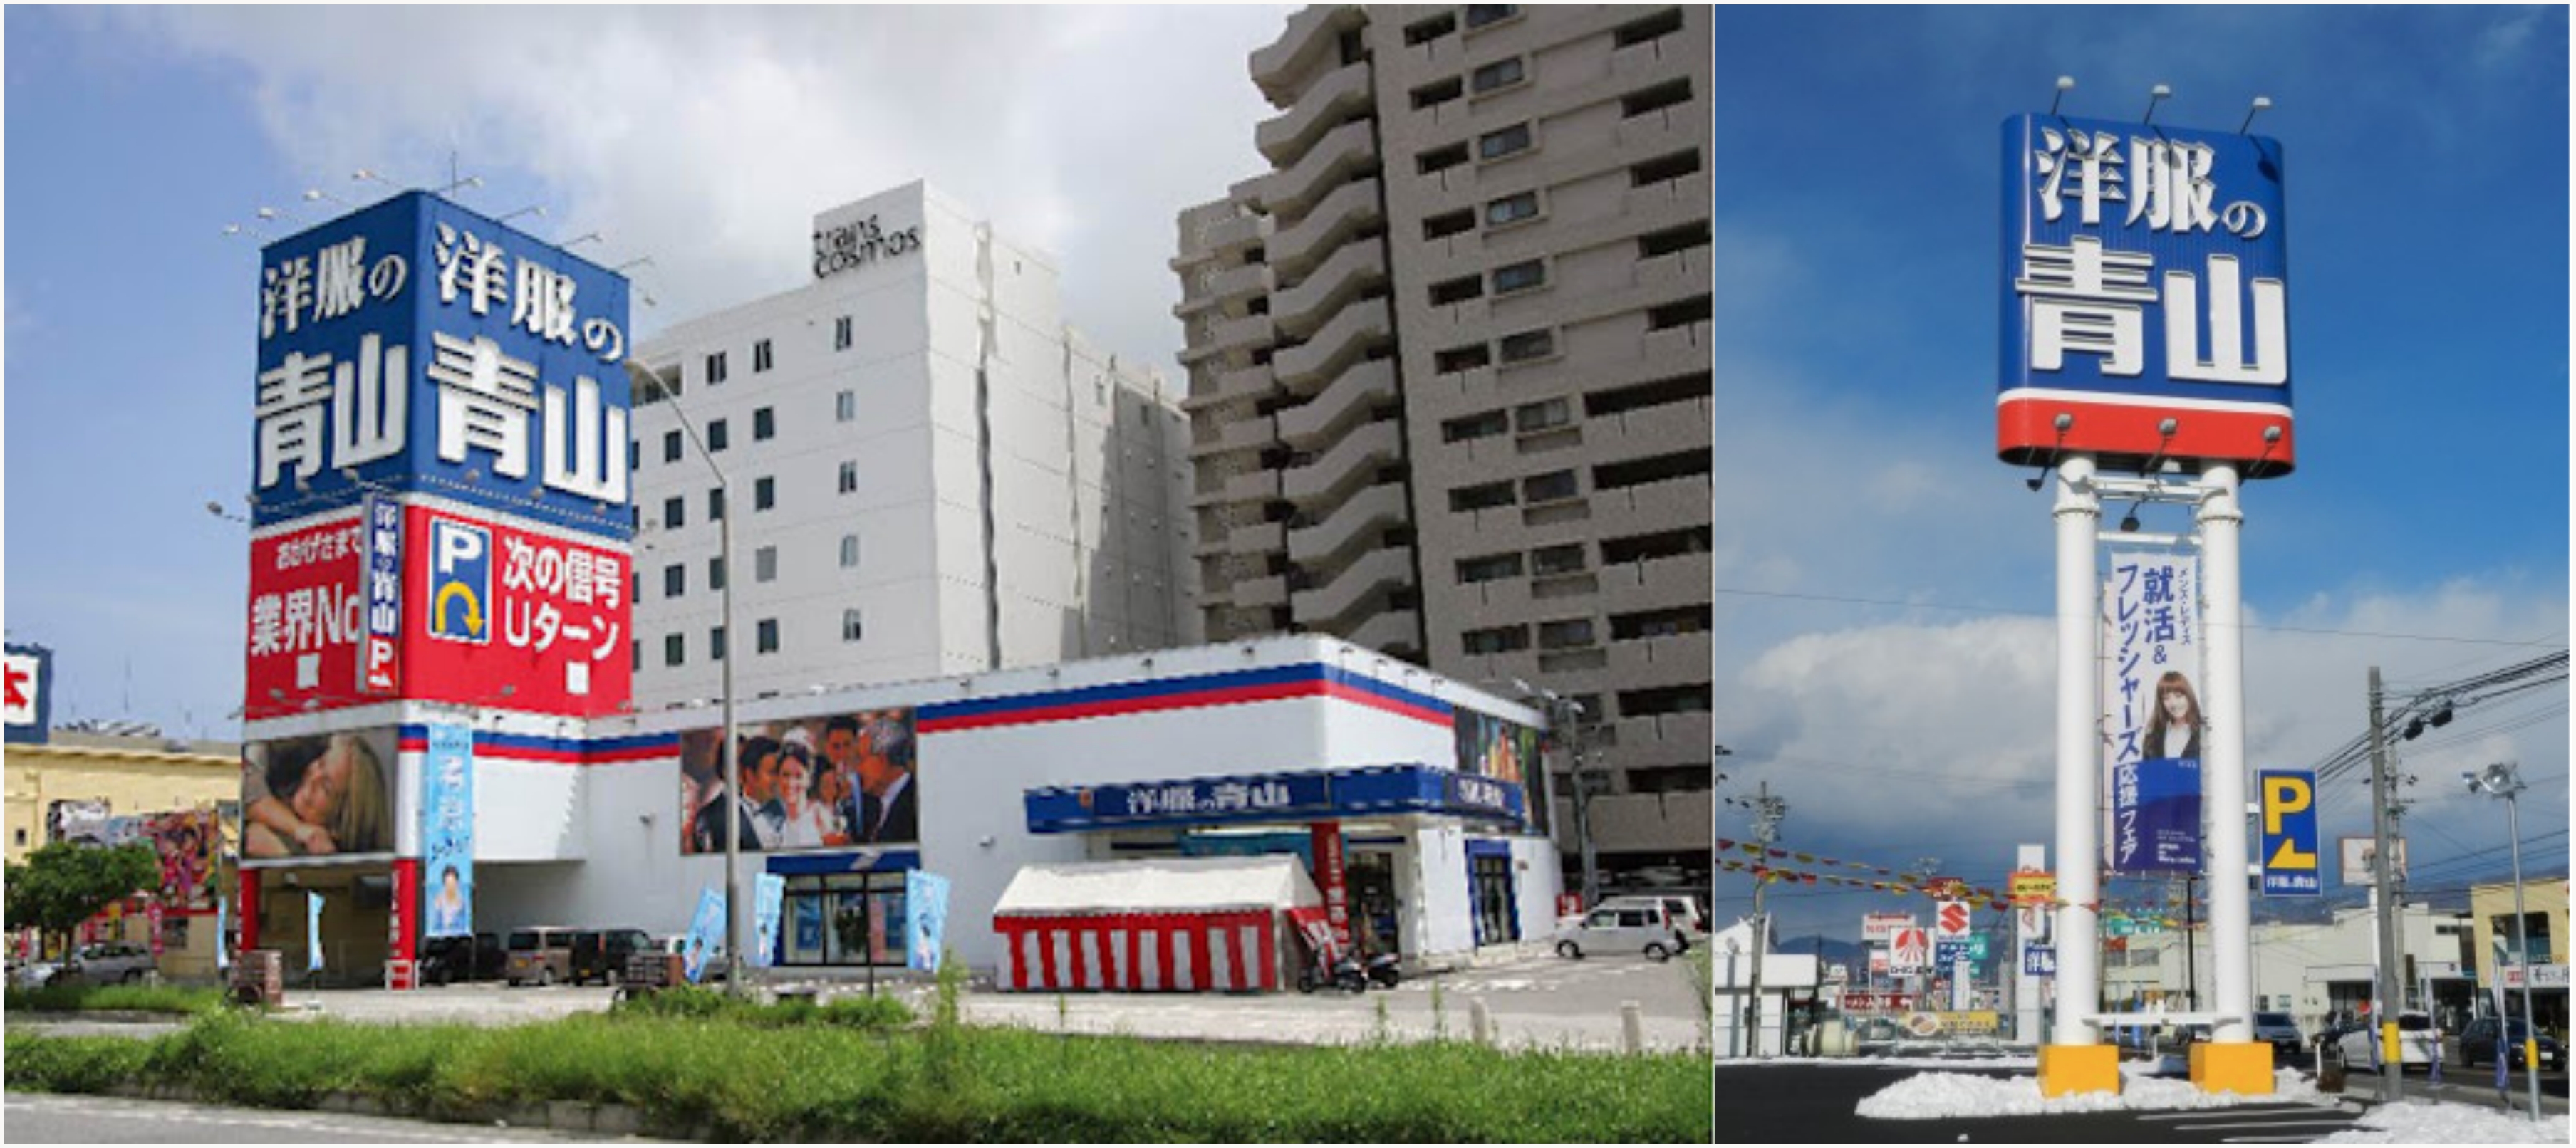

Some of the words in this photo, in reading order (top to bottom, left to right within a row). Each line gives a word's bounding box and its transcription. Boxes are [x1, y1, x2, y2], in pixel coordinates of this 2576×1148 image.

[2034, 125, 2268, 239] 洋服の
[261, 235, 408, 340] 洋服の
[432, 221, 624, 363] 洋服の
[813, 224, 920, 279] cosmos
[2015, 234, 2287, 385] 青山
[256, 332, 408, 489] 青山
[427, 330, 628, 505] 青山
[437, 523, 483, 575] P
[502, 534, 622, 610] 次の信号
[370, 637, 393, 672] P
[504, 595, 618, 661] Uターン
[2142, 565, 2176, 664] 就活&
[2263, 776, 2312, 835] P
